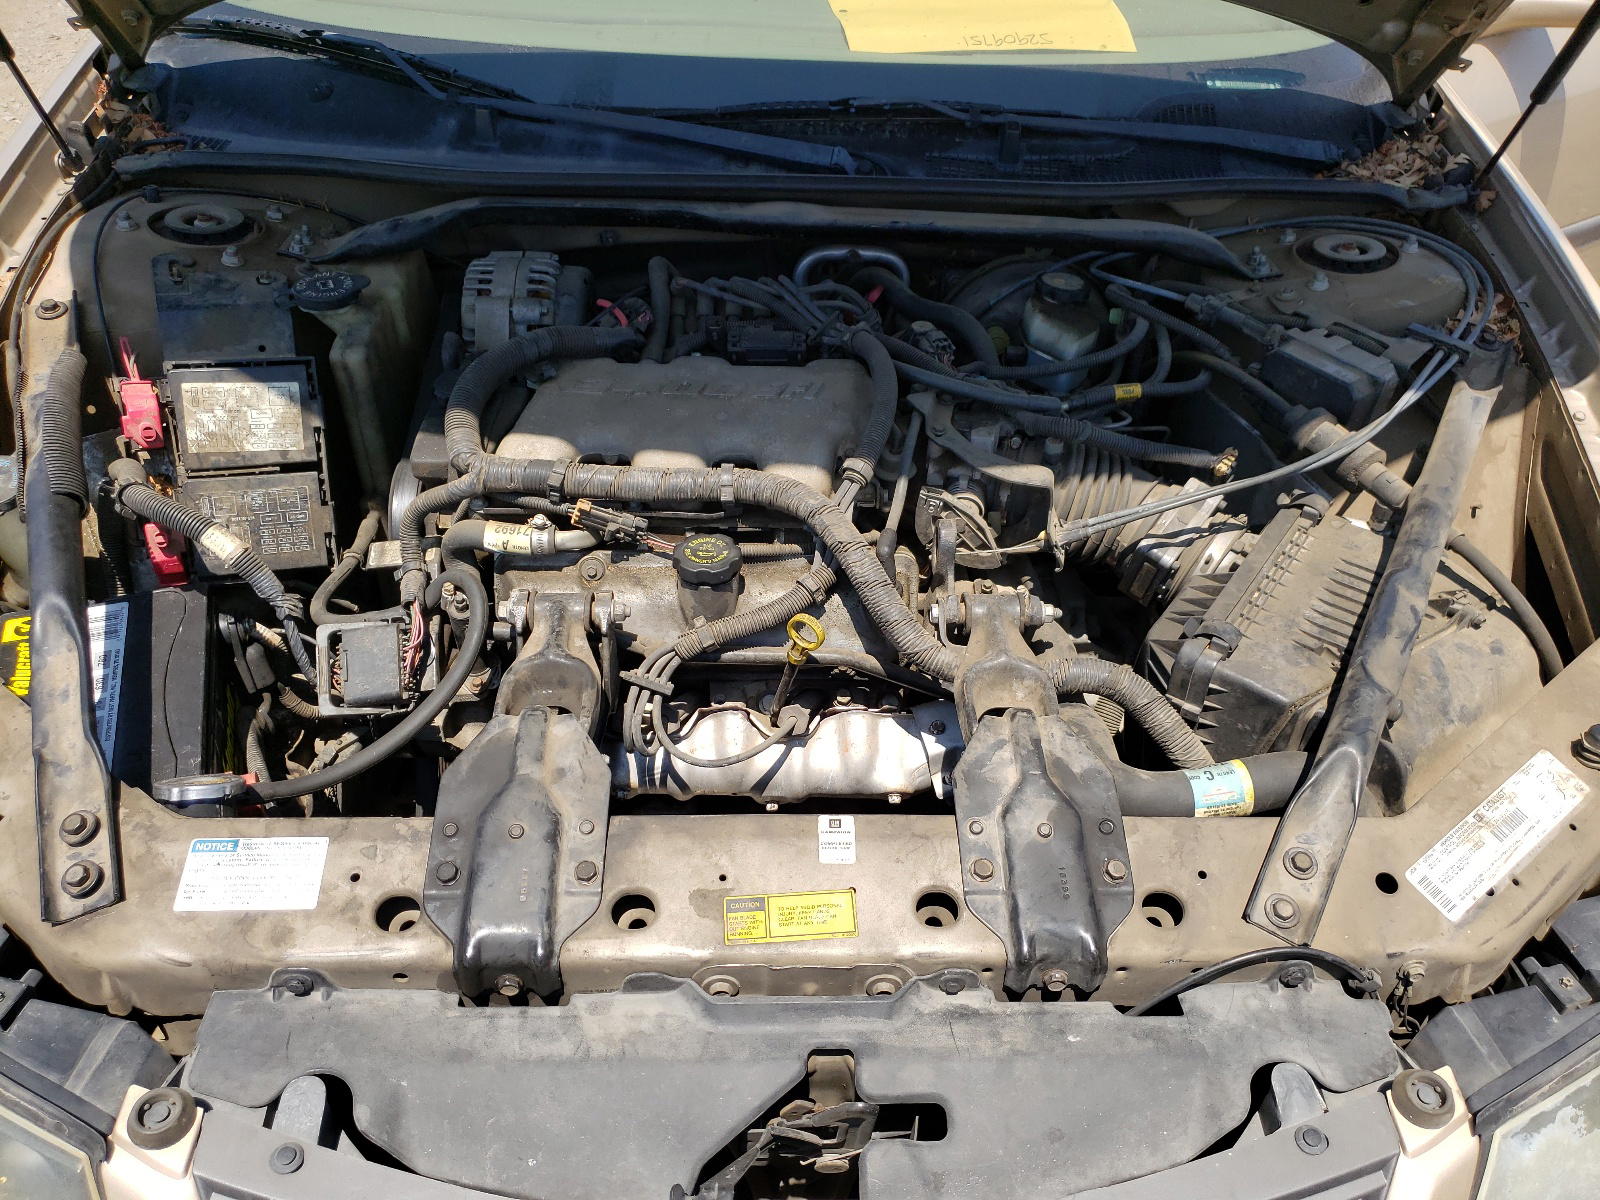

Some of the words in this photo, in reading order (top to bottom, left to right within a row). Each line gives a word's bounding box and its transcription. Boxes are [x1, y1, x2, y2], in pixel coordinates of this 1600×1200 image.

[494, 525, 530, 537] 71692
[502, 540, 510, 550] A
[1203, 770, 1215, 781] C
[1482, 786, 1506, 812] CATALYST
[194, 840, 235, 851] NOTICE
[730, 901, 760, 909] CAUTION
